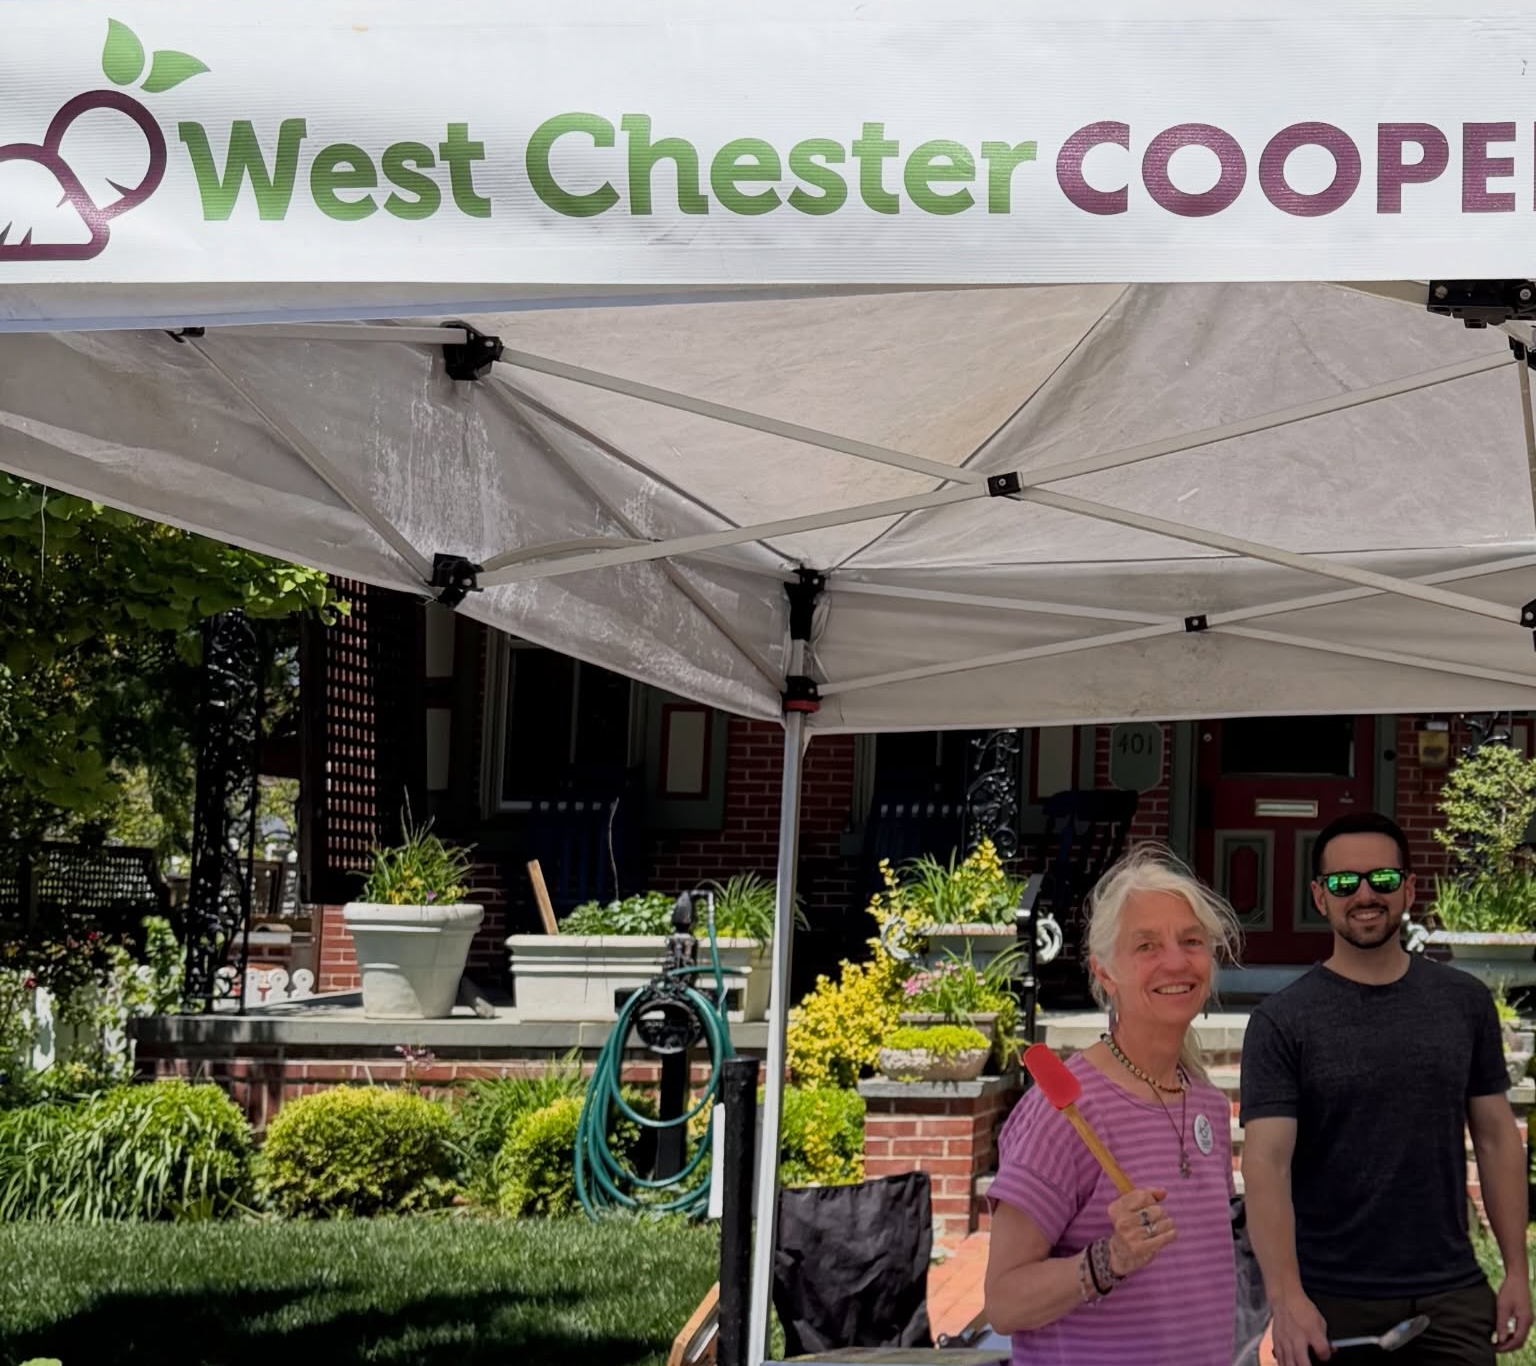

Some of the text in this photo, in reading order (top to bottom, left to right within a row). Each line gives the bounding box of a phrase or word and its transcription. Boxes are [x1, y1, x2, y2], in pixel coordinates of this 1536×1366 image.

[178, 117, 492, 222] West
[525, 112, 1037, 218] Chester
[1117, 733, 1152, 755] 401
